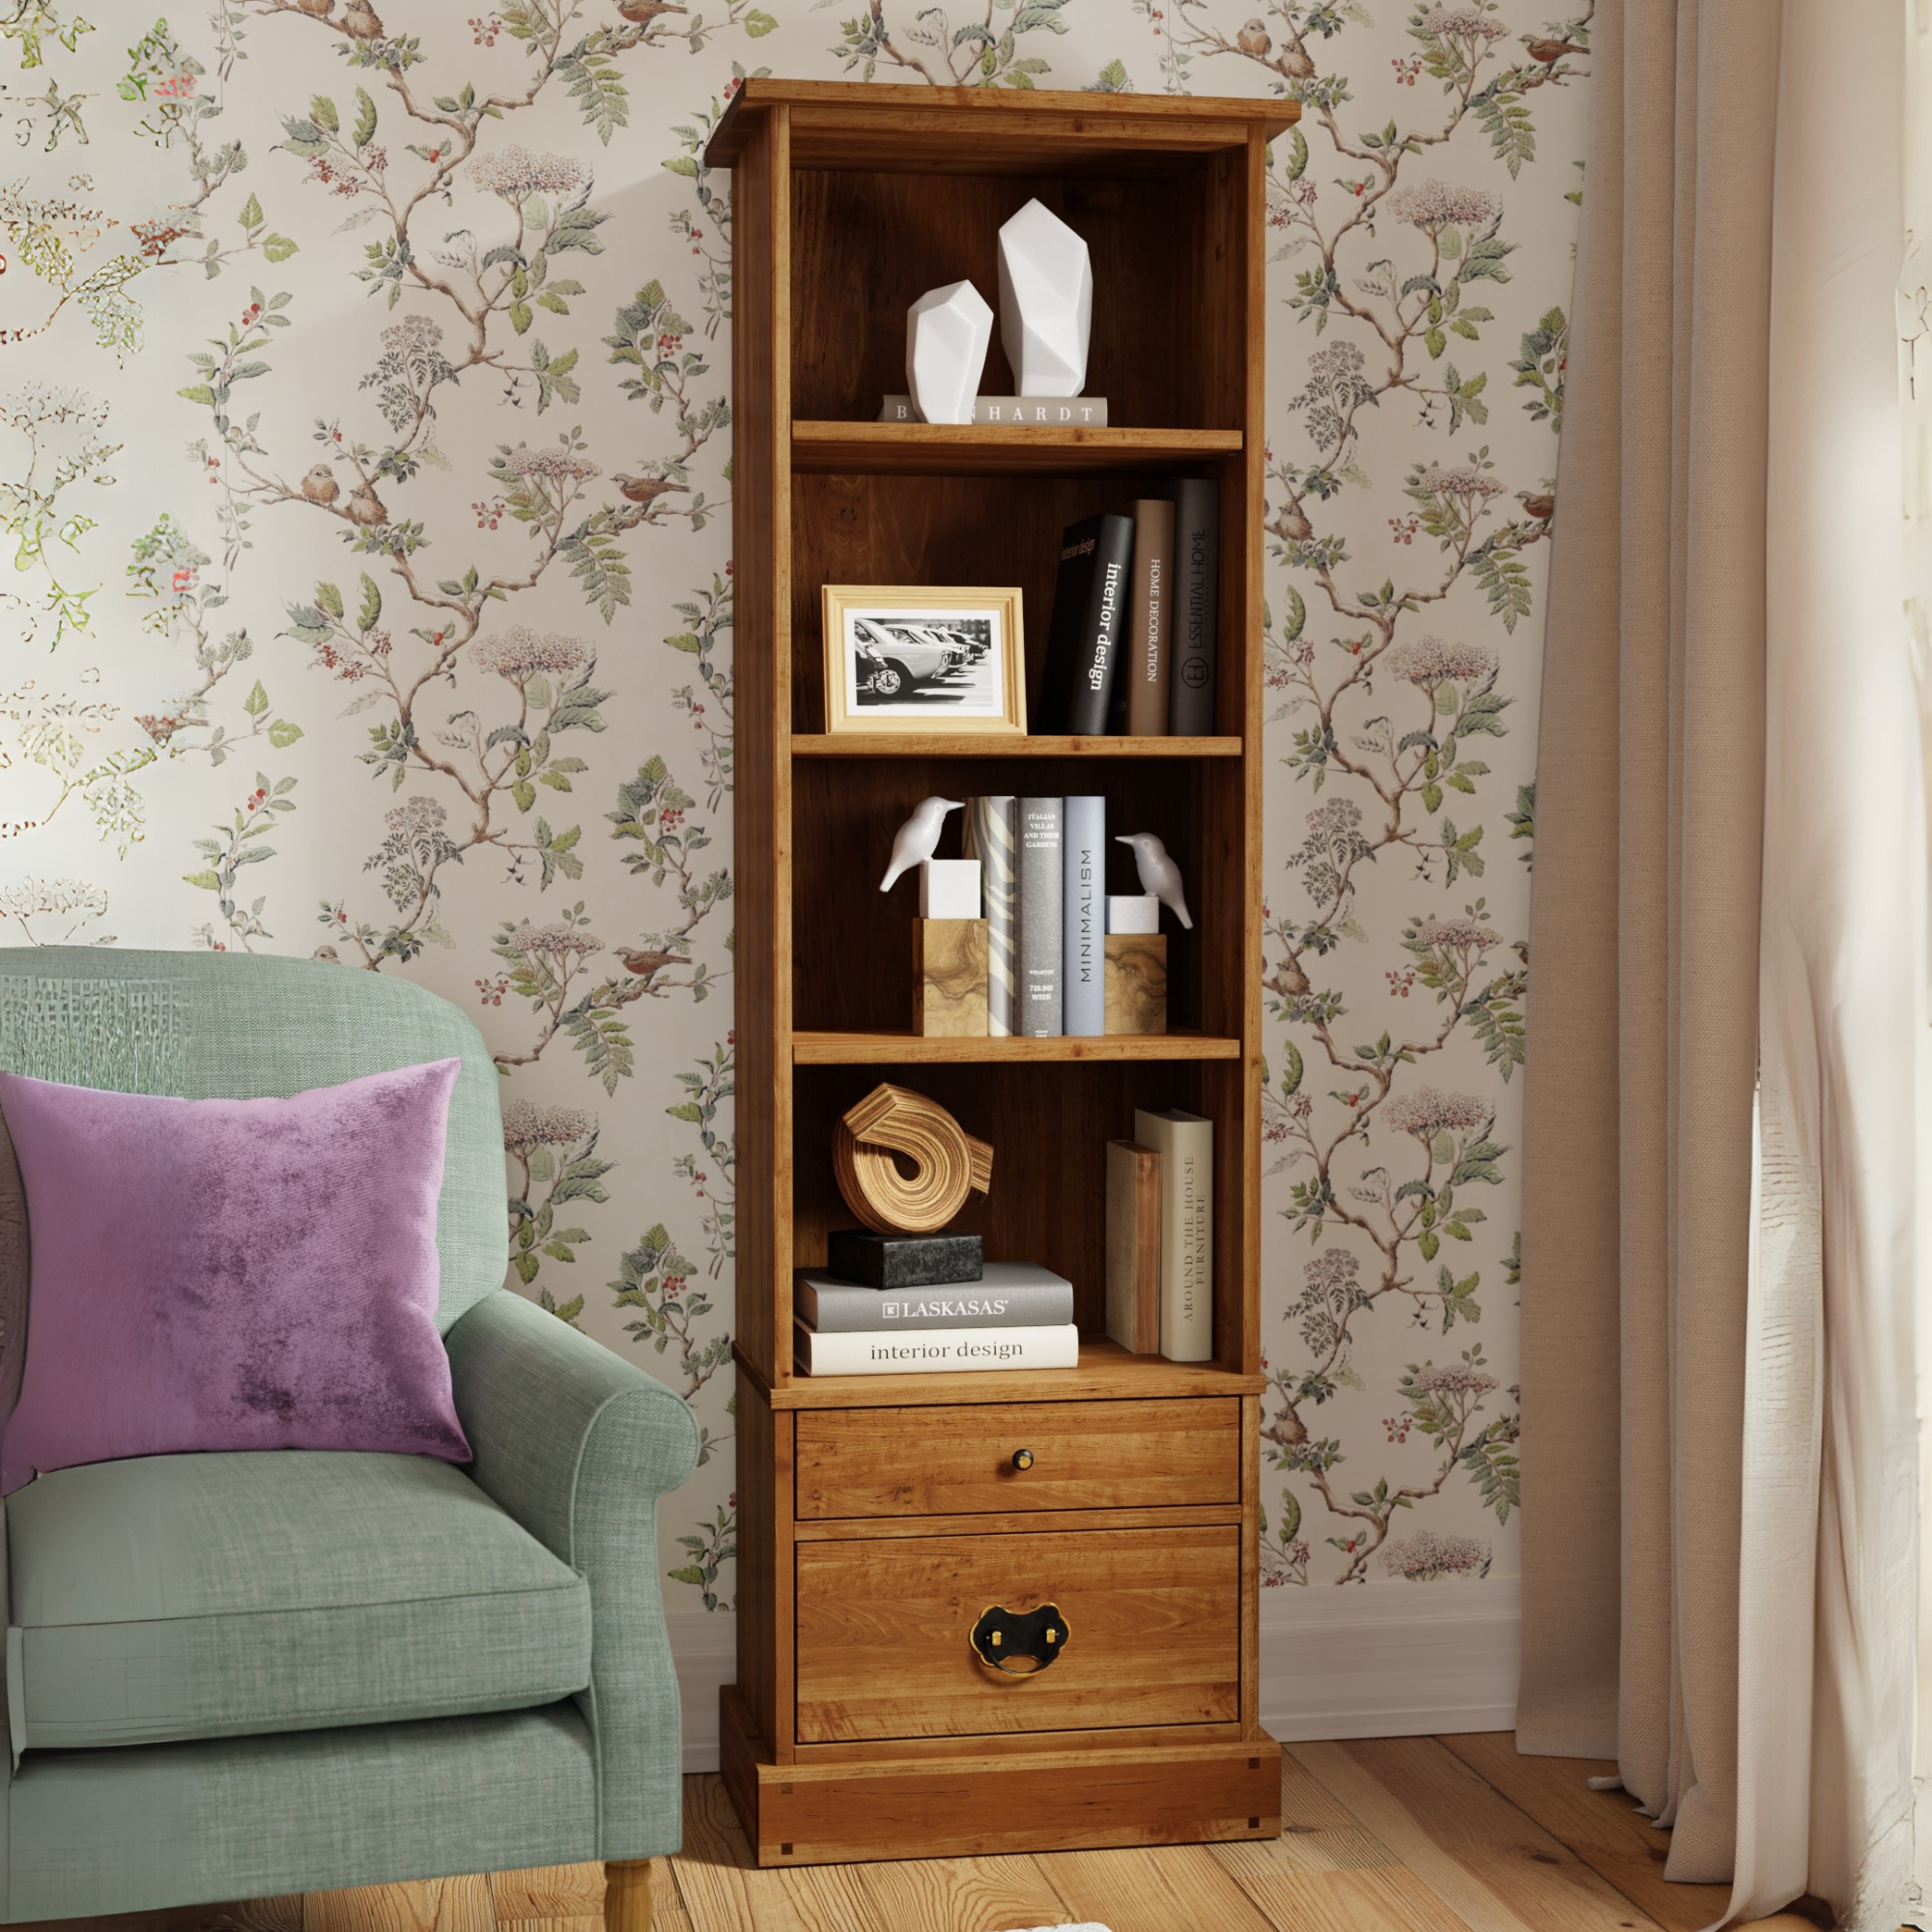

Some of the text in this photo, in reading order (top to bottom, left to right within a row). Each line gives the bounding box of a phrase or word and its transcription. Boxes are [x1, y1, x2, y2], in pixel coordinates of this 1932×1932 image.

[896, 405, 1093, 420] BHARDT
[1089, 562, 1122, 691] interior design
[1148, 559, 1161, 682] HOME DECORATION
[1189, 528, 1206, 649] ESSENTIAL HOME
[1081, 849, 1092, 982] MINIMALISM
[1183, 1156, 1194, 1322] AROUND THE HOUSE
[1196, 1194, 1206, 1285] FURNITURE
[870, 1341, 1023, 1360] interior design
[902, 1299, 1007, 1318] LASKASAS
